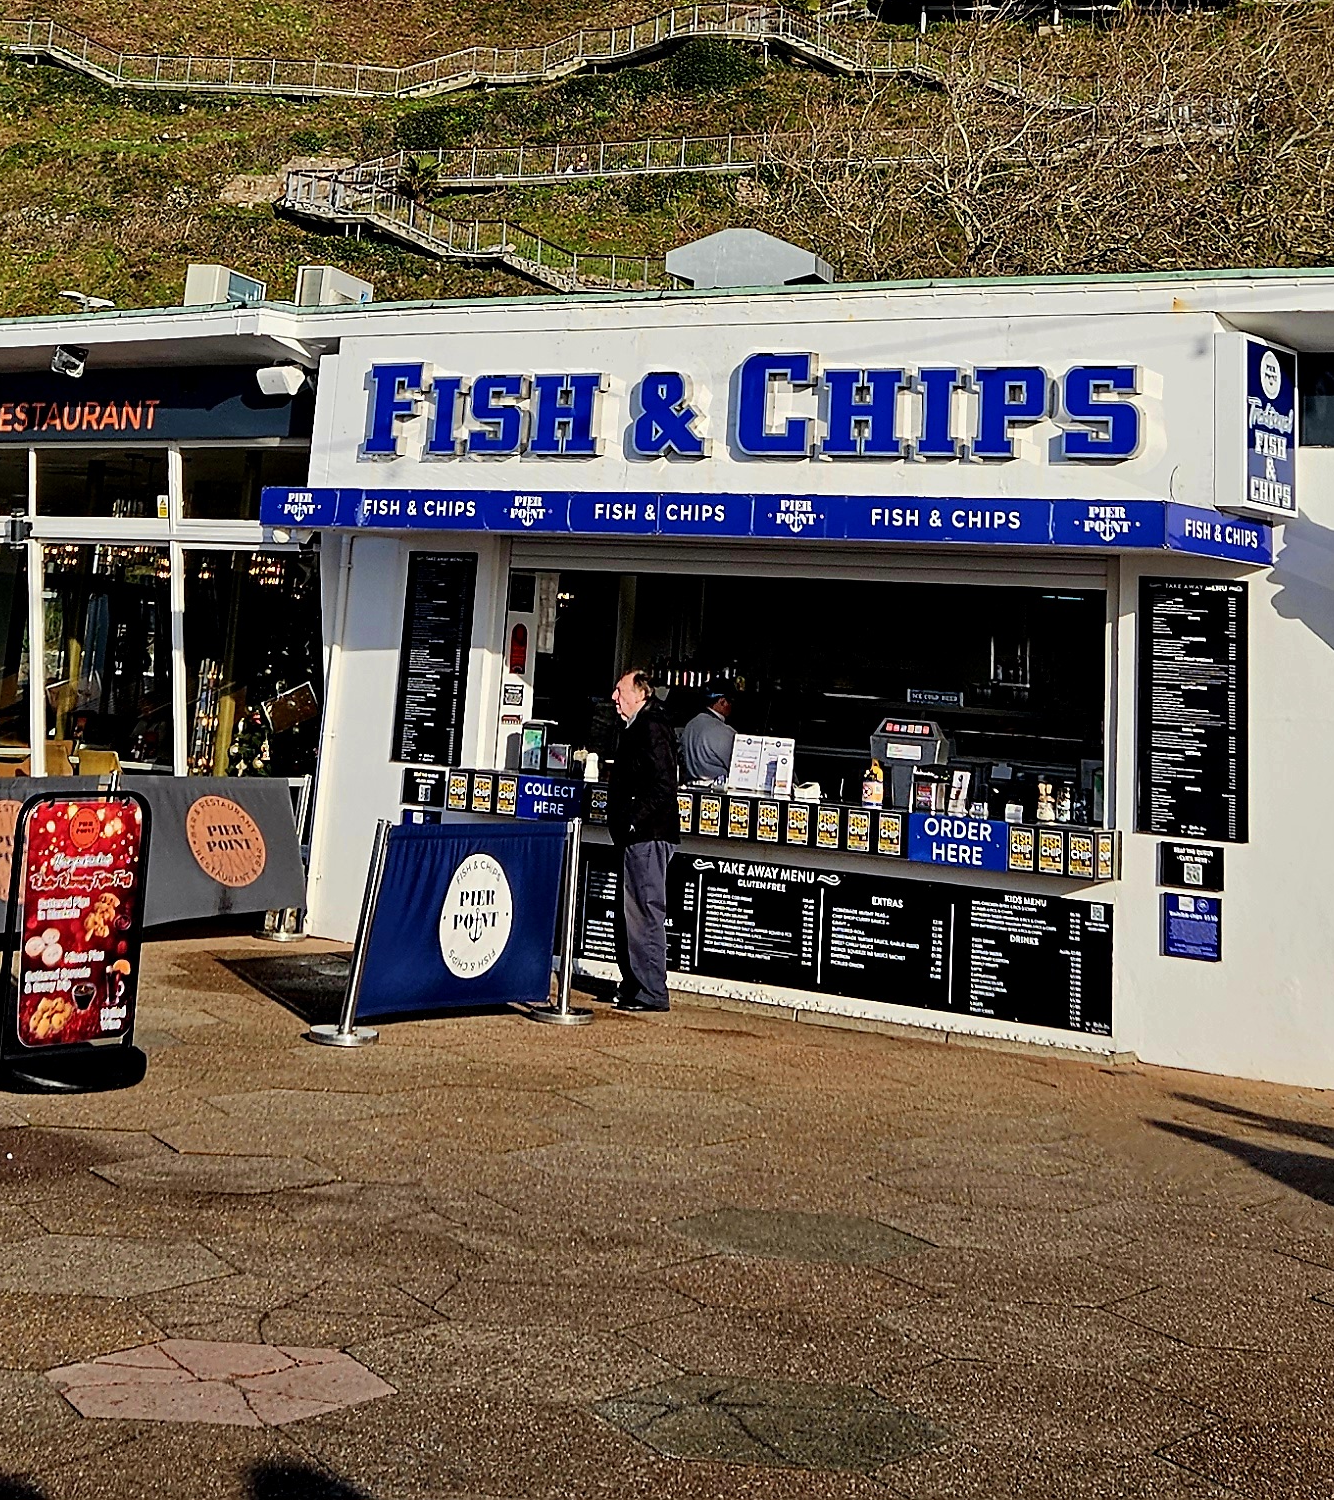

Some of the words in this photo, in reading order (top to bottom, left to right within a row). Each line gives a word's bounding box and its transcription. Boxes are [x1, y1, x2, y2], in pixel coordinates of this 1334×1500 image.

[360, 360, 607, 460] FISH
[627, 369, 710, 460] &
[733, 349, 1146, 461] CHIPS
[1254, 429, 1287, 461] FISH
[1265, 457, 1277, 481] &
[287, 493, 312, 504] PIER
[1250, 476, 1292, 509] CHIPS
[363, 499, 400, 516] FISH
[407, 500, 417, 515] &
[424, 500, 476, 518] CHIPS
[514, 495, 542, 507] PIER
[780, 499, 812, 512] PIER
[594, 503, 637, 520] FISH
[644, 504, 656, 521] &
[666, 504, 726, 522] CHIPS
[871, 509, 920, 527] FISH
[929, 510, 943, 528] &
[952, 510, 1021, 529] CHIPS
[1088, 505, 1127, 519] PIER
[1185, 518, 1212, 540] FISH
[1214, 526, 1222, 542] &
[1225, 527, 1259, 549] CHIPS
[524, 782, 575, 799] COLLECT
[534, 801, 565, 815] HERE
[207, 824, 244, 838] PIER
[924, 817, 992, 842] ORDER
[206, 837, 254, 853] POINT
[1012, 834, 1032, 845] FISH
[1041, 837, 1061, 848] FISH
[1071, 840, 1091, 851] FISH
[932, 842, 983, 866] HERE
[457, 863, 472, 885] FISH
[480, 860, 501, 882] CHIPS
[718, 861, 746, 876] TAKE
[747, 865, 779, 880] AWAY
[780, 869, 814, 884] MENU
[737, 879, 767, 889] GLUTEN
[767, 882, 786, 892] FREE
[459, 890, 495, 907] PIER
[871, 896, 904, 908] EXTRAS
[1004, 895, 1023, 904] KIDS
[1024, 897, 1047, 907] MENU
[1009, 934, 1039, 945] DRINKS
